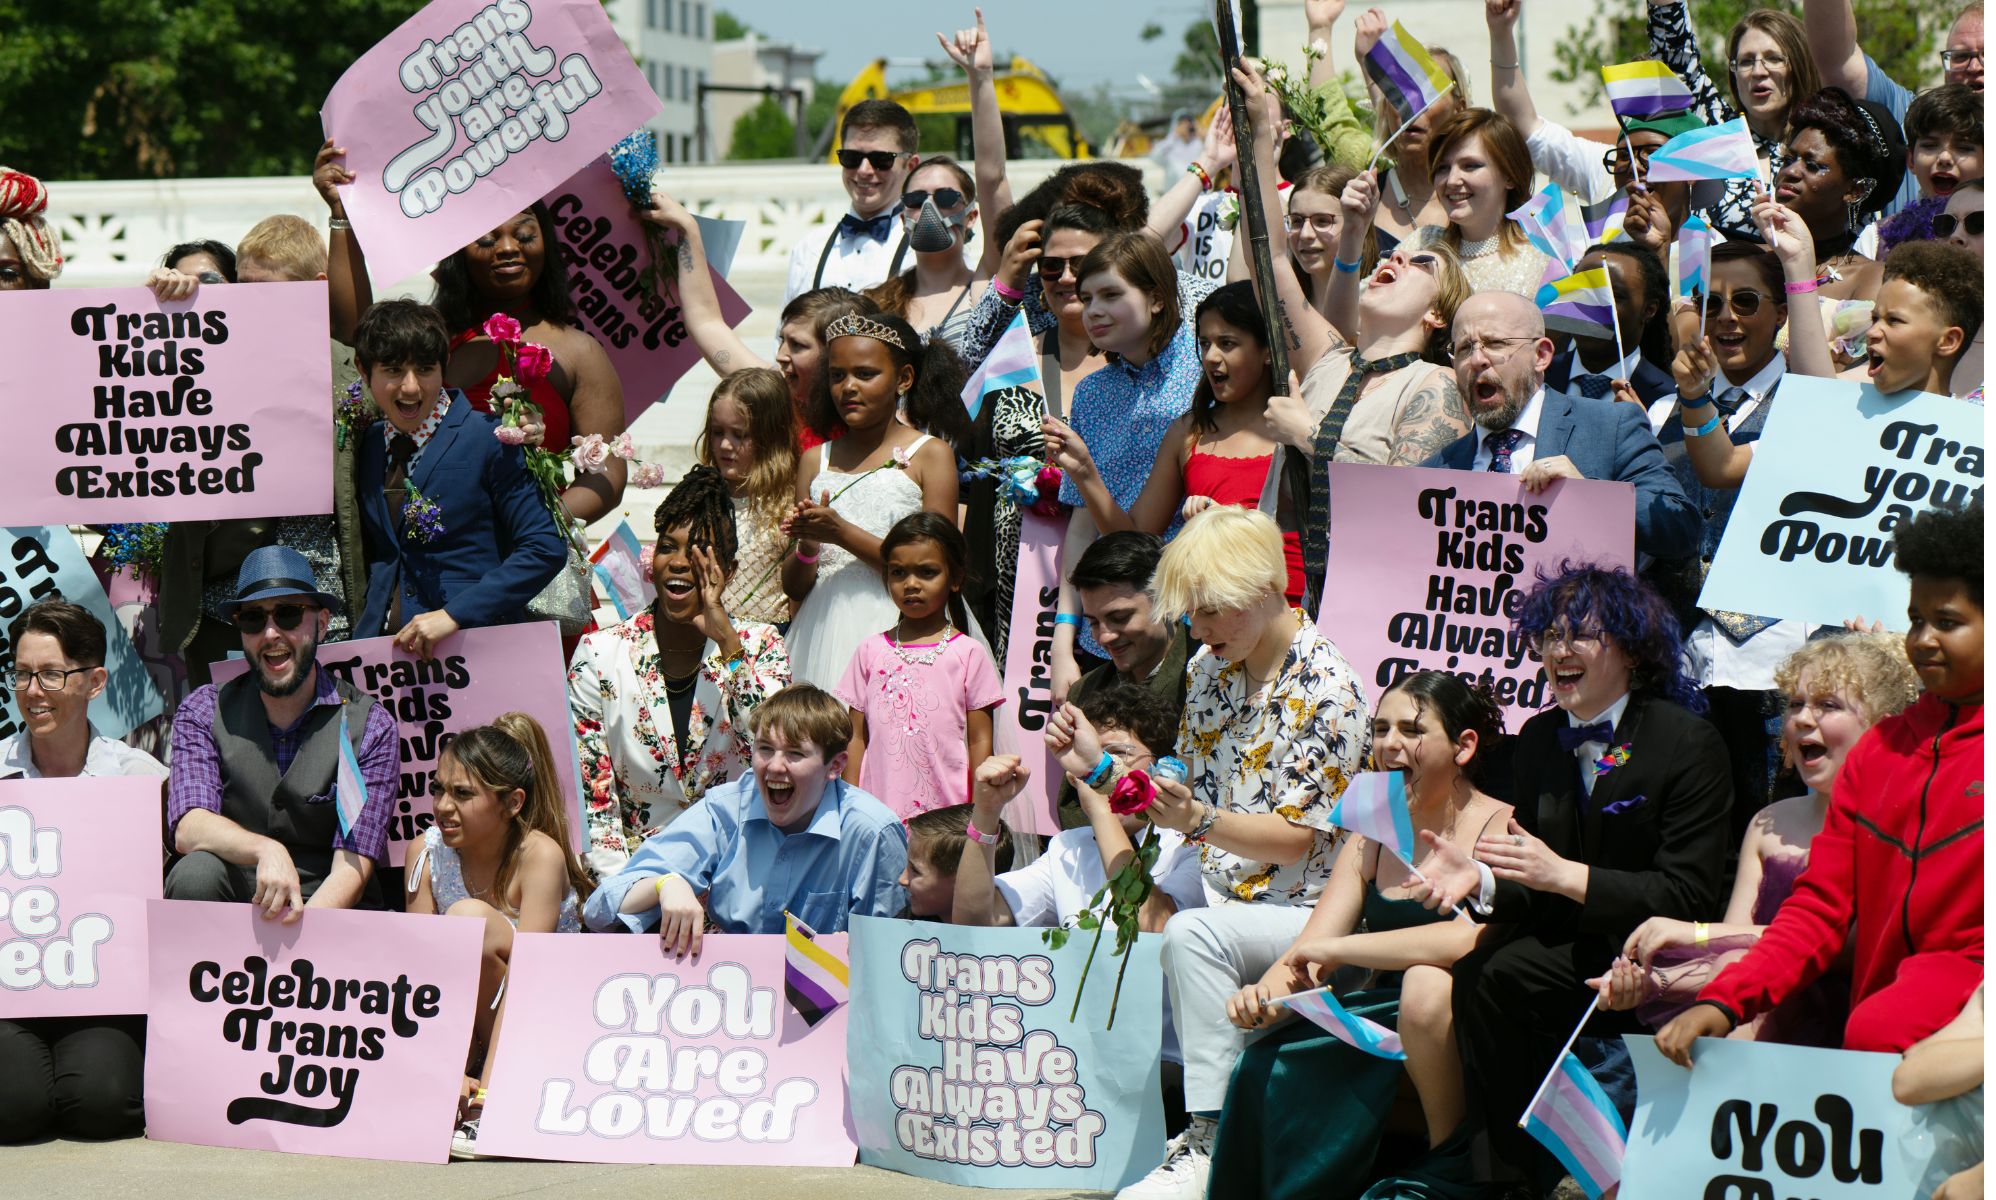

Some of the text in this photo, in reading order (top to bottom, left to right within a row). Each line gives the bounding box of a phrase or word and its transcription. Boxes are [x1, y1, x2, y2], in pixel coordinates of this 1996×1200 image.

[399, 0, 532, 93] Trans
[383, 32, 556, 193] youth
[400, 53, 602, 218] Powerful
[460, 73, 533, 142] are
[1192, 258, 1229, 279] NO
[1196, 235, 1213, 257] IS
[70, 303, 229, 345] Trans
[99, 336, 206, 378] Kids
[94, 375, 213, 419] Have
[55, 420, 253, 457] Always
[55, 452, 263, 499] Existed
[1418, 487, 1547, 543] Trans
[1436, 525, 1524, 574] Kids
[1426, 573, 1526, 619] Have
[370, 685, 452, 722] ids
[189, 955, 441, 1037] Celebrate
[593, 961, 777, 1040] You
[901, 938, 1055, 1006] Trans
[222, 1008, 385, 1061] Trans
[918, 987, 1024, 1044] Kids
[583, 1033, 768, 1097] Are
[942, 1029, 1078, 1086] Have
[227, 1054, 360, 1128] Joy
[534, 1077, 819, 1143] Loved
[890, 1065, 1085, 1130] Always
[895, 1110, 1106, 1168] Existed
[1711, 1094, 1884, 1185] You
